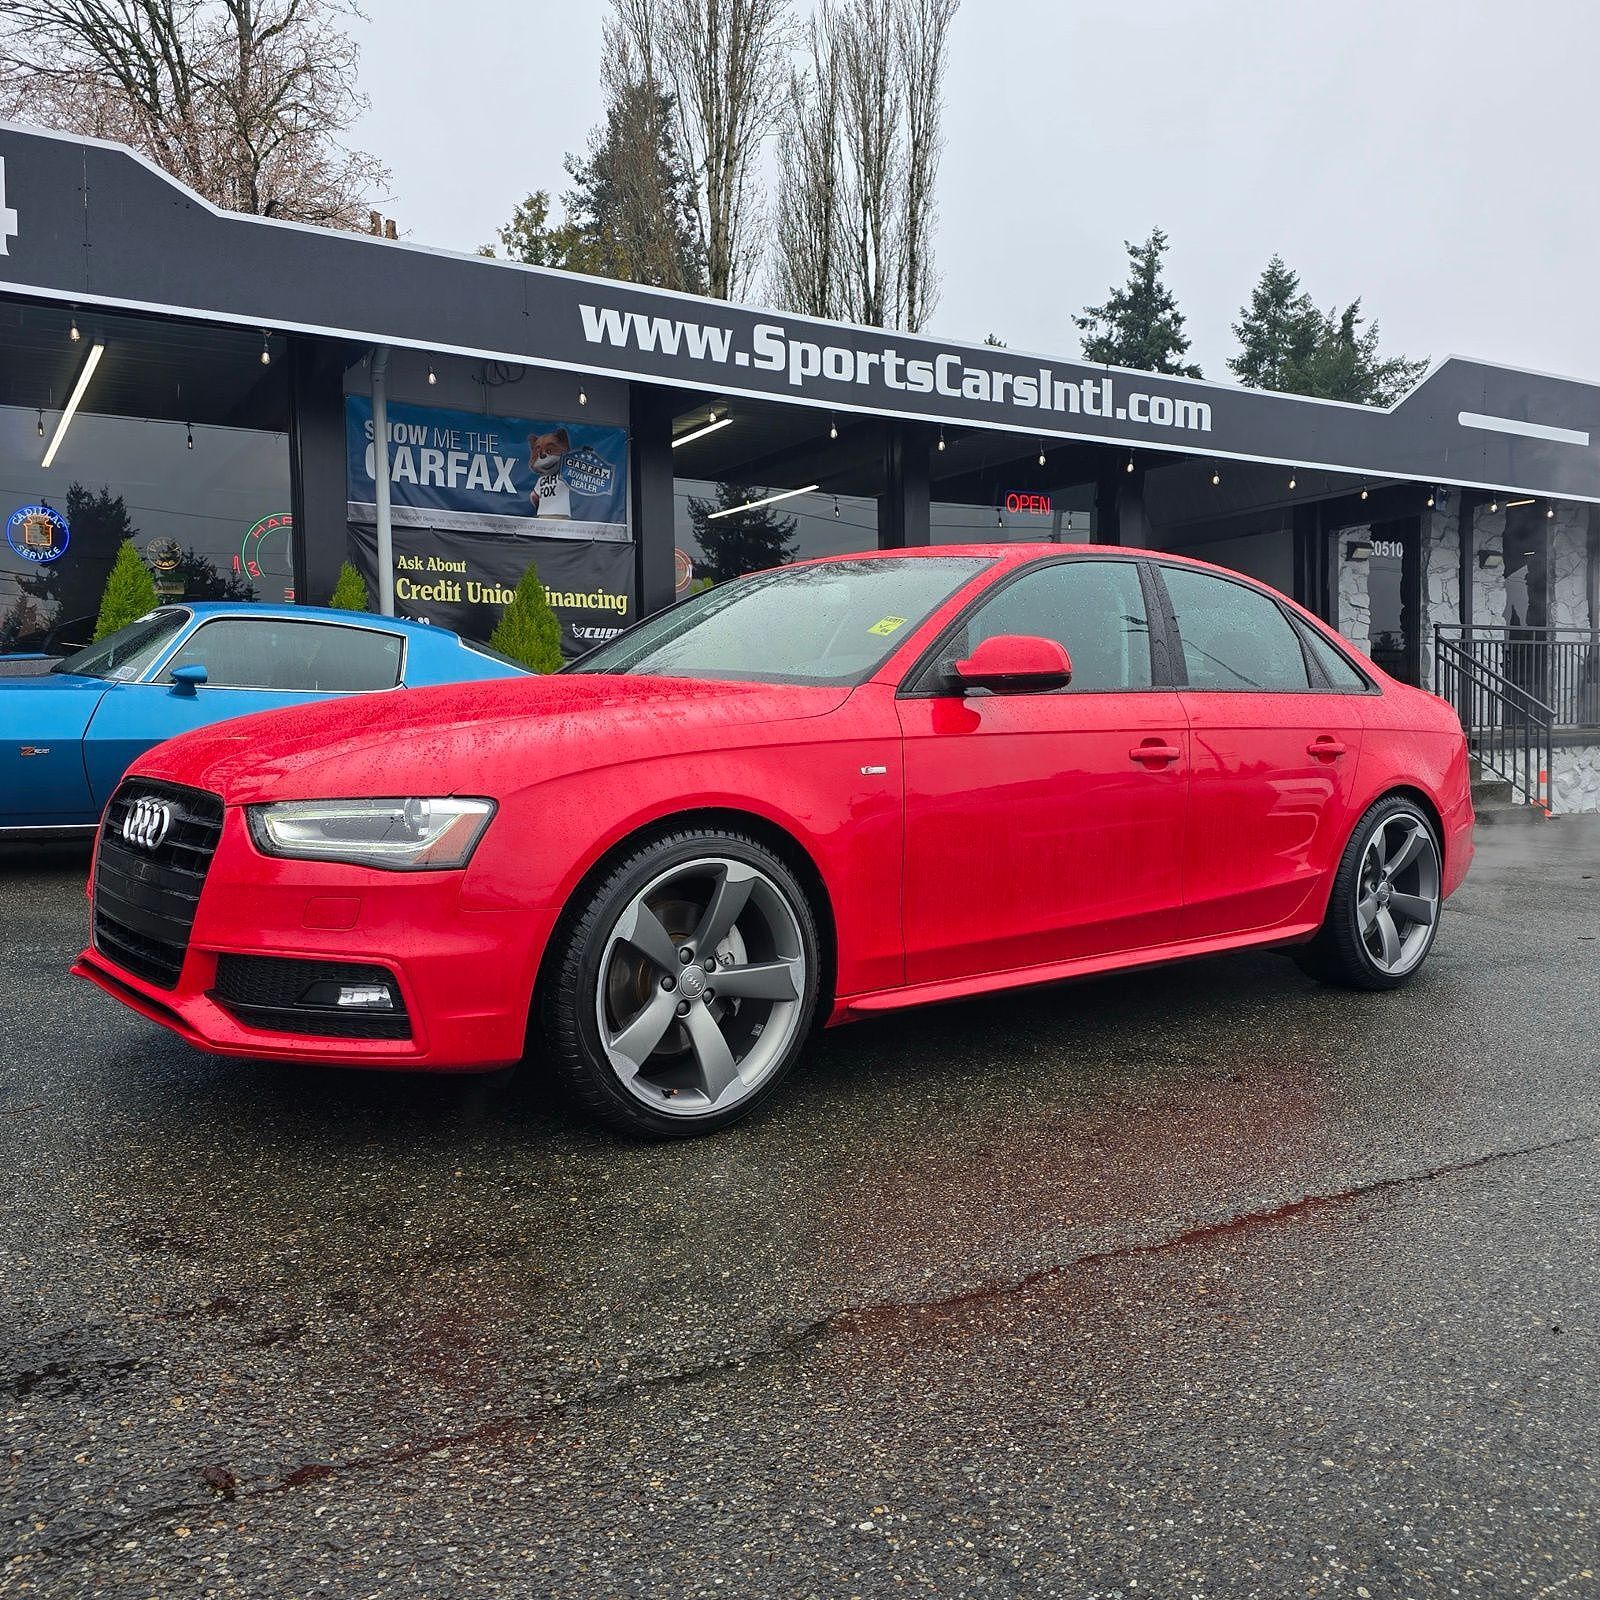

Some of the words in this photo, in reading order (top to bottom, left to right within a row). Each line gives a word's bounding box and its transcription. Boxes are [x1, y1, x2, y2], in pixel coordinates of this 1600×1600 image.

[578, 303, 1212, 432] www.SportsCarsIntl.com
[433, 427, 461, 450] ME
[465, 431, 499, 454] THE
[566, 458, 611, 480] CARFAX
[567, 469, 607, 488] ADVANTAGE
[539, 473, 558, 488] CAR
[570, 479, 598, 493] DEALER
[540, 485, 557, 498] FOX
[1006, 493, 1051, 516] OPEN
[12, 507, 65, 529] CADILLAC
[17, 544, 61, 560] SERVICE
[397, 555, 424, 571] Ask
[426, 556, 467, 573] About
[396, 577, 462, 602] Credit
[466, 581, 518, 605] Unio
[539, 585, 628, 616] inancing
